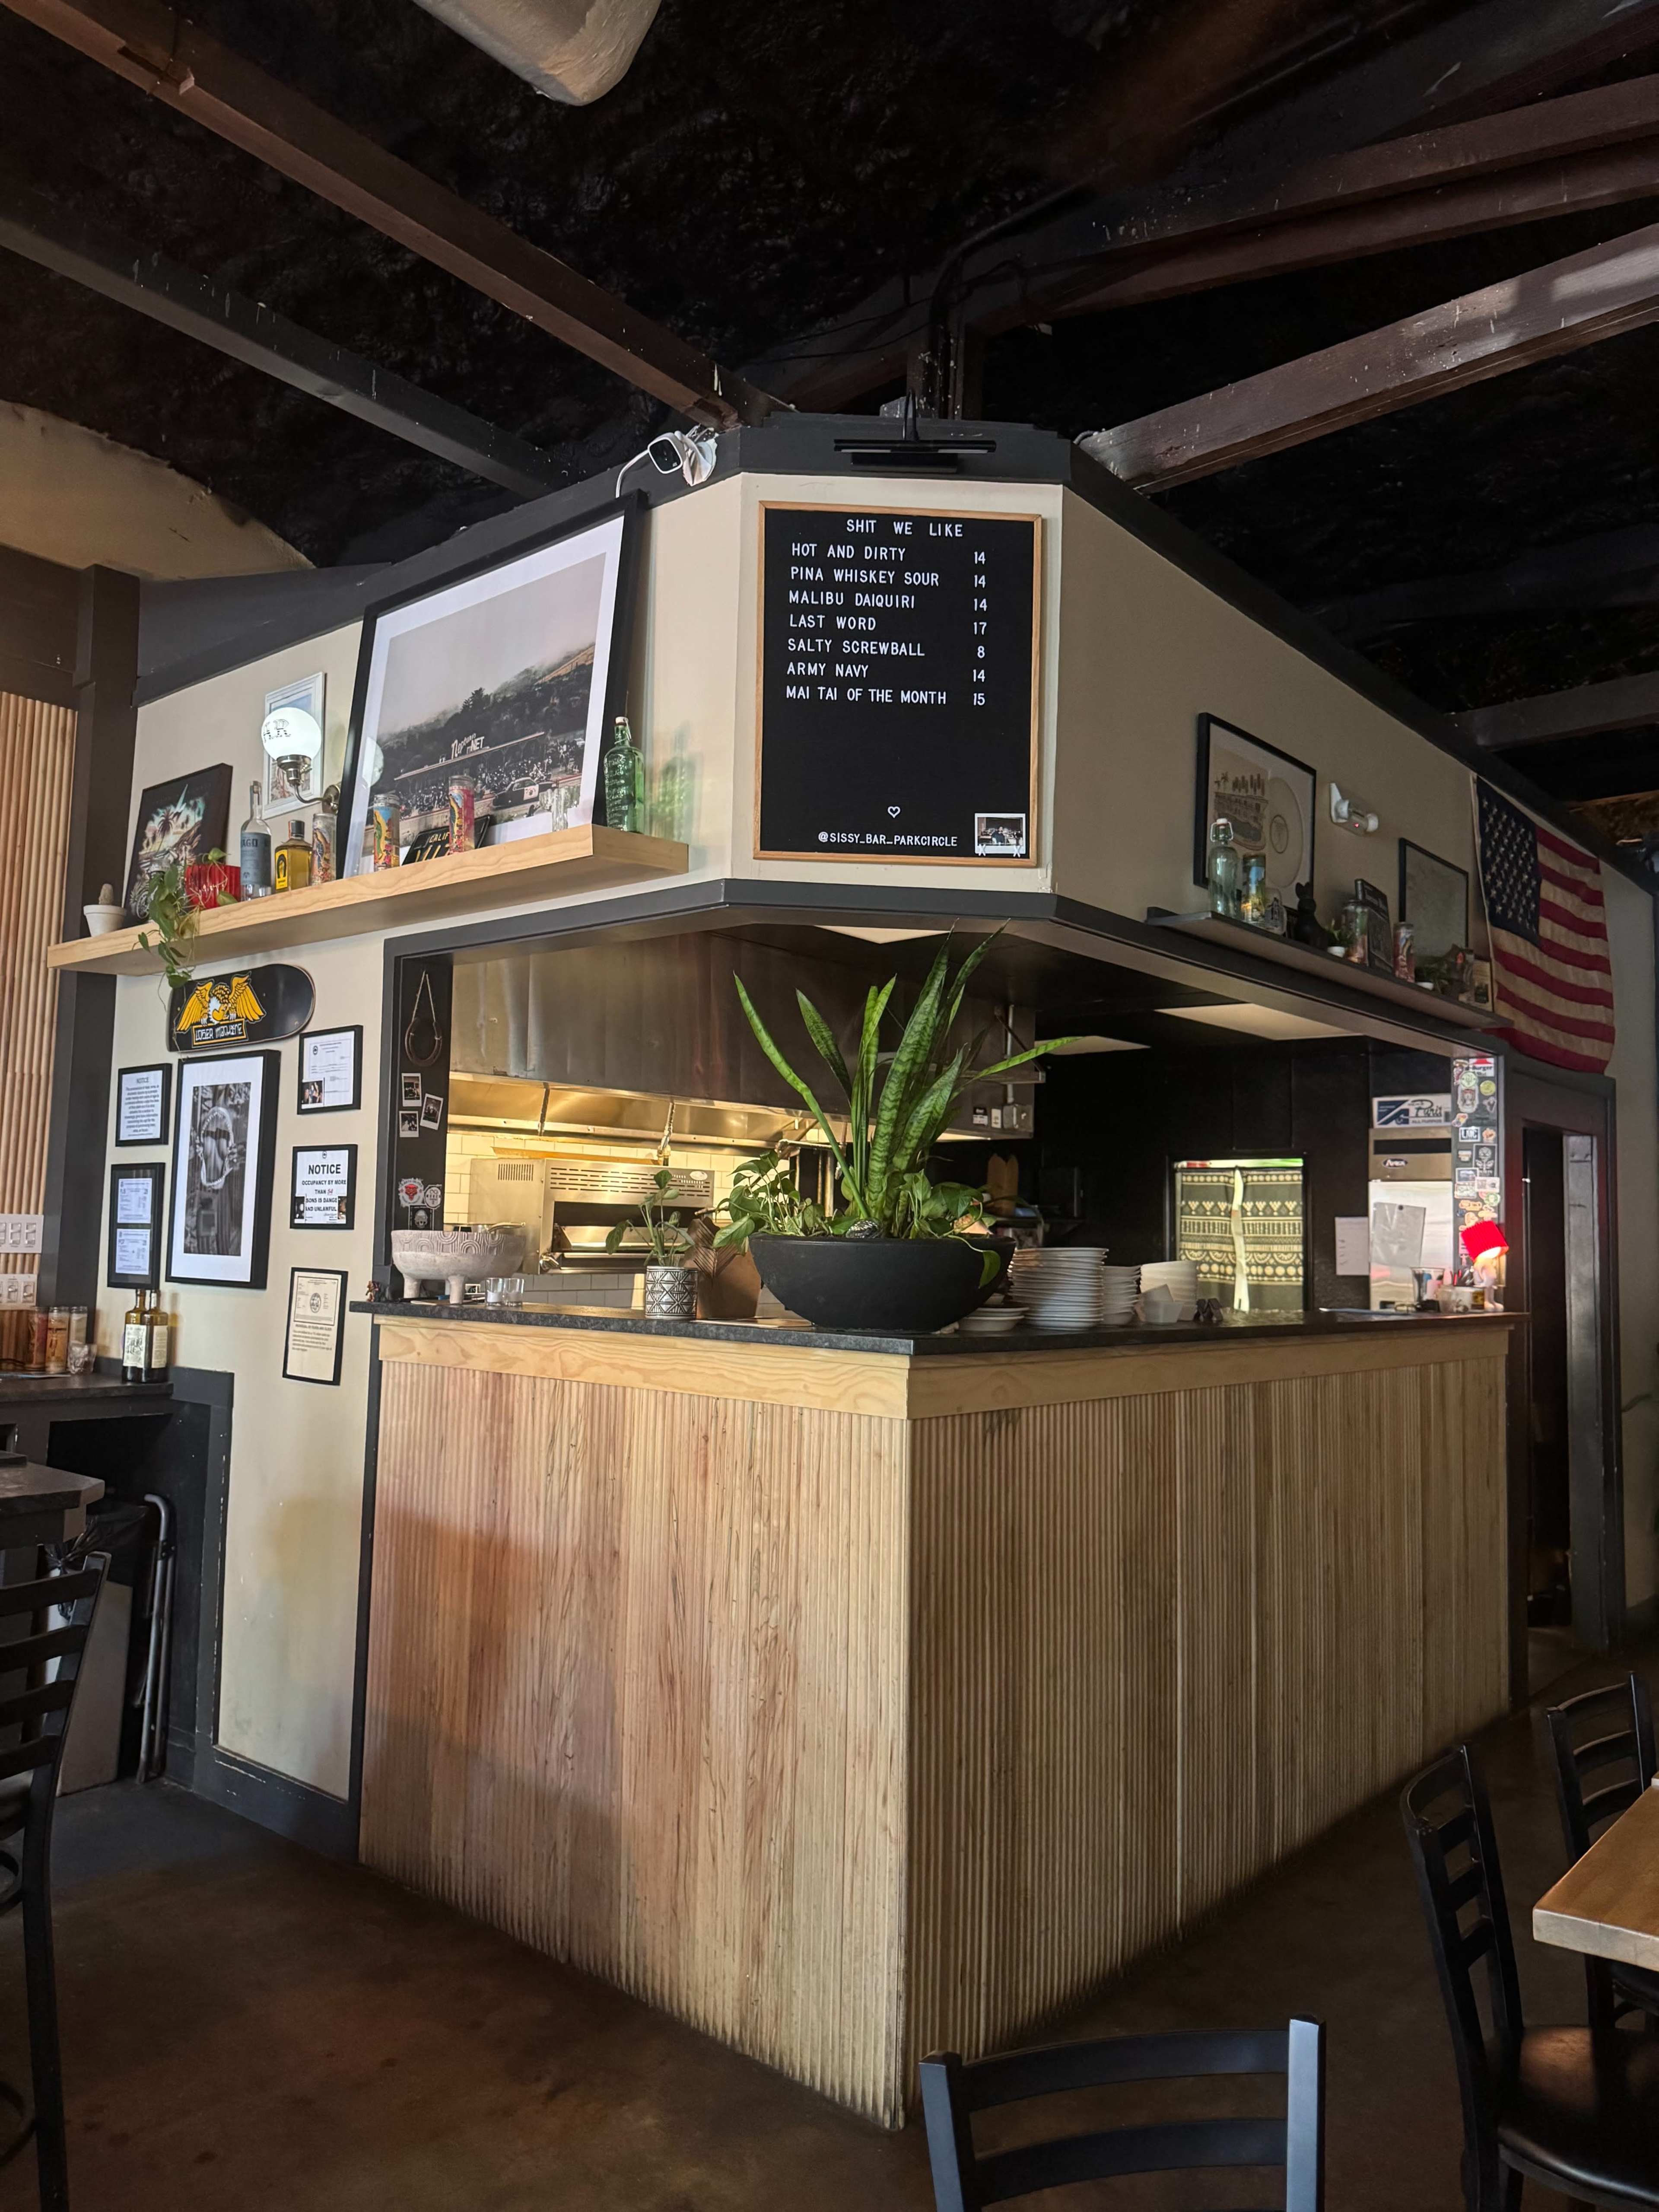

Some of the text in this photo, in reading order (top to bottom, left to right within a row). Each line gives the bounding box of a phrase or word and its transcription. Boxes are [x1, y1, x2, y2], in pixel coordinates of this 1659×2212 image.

[846, 519, 963, 537] SHIT WE LIKE
[792, 542, 985, 565] HOT AND DIRTY 14
[791, 566, 986, 588] PINA WHISKEY SOUR 14
[789, 590, 987, 611] MALIBU DAIQUIRI 14
[790, 614, 987, 635] LAST WORD 17
[788, 638, 985, 659] SALTY SCREWBALL 8
[787, 662, 985, 682] ARMY NAVY 14
[786, 685, 985, 706] MAI TAI OF THE MONTH 15
[470, 736, 485, 751] NET
[818, 831, 958, 847] @SISSY_BAR_PARKCIRCLE
[308, 1164, 341, 1175] NOTICE
